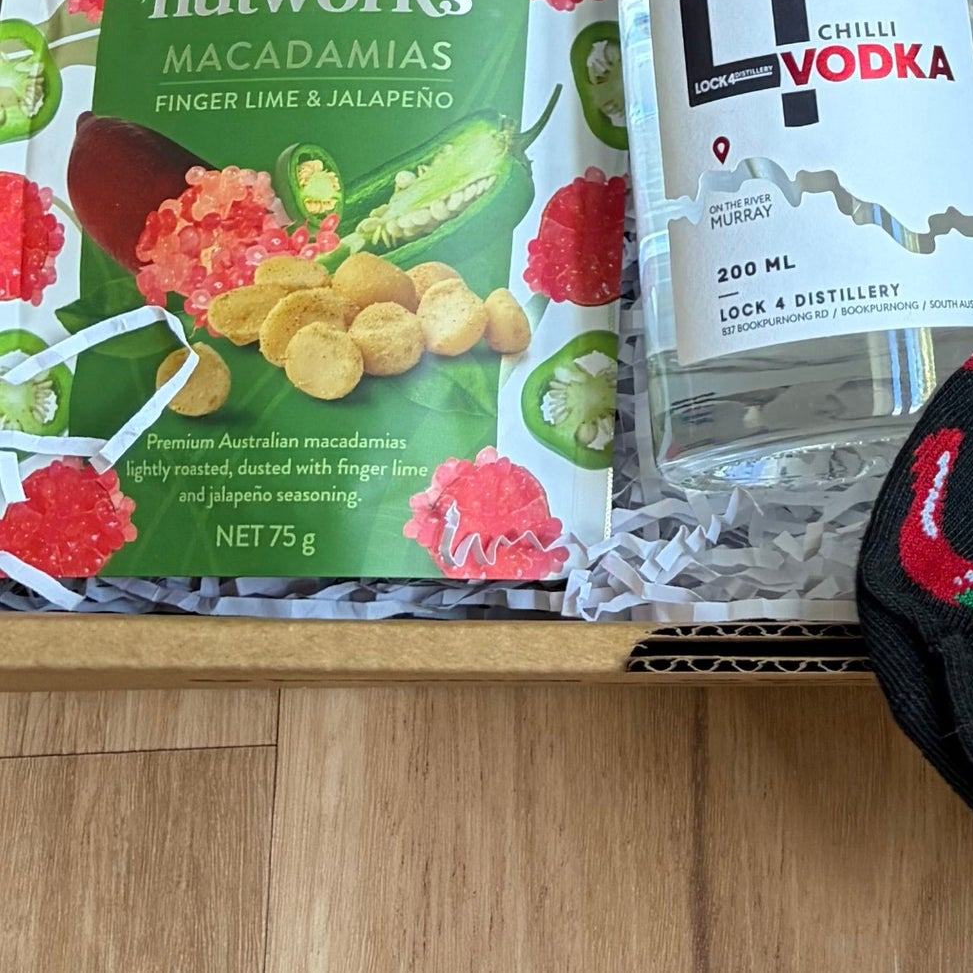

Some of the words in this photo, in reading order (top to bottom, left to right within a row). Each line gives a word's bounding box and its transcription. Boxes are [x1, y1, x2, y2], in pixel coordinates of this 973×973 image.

[818, 21, 896, 41] CHILLI
[162, 39, 452, 74] MACADAMIAS
[780, 43, 955, 87] VODKA
[735, 65, 773, 79] DISTILLERY
[155, 91, 239, 112] FINGER
[245, 90, 300, 109] LIME
[306, 90, 322, 108] &
[326, 86, 454, 109] JALAPEÑO
[709, 205, 723, 215] ON
[724, 199, 742, 210] THE
[744, 193, 771, 206] RIVER
[710, 204, 773, 230] MURRAY
[717, 261, 757, 283] 200
[765, 255, 796, 273] ML
[720, 299, 766, 322] LOCK
[775, 297, 786, 310] 4
[795, 283, 900, 307] DISTILLERY
[722, 325, 736, 336] 837
[737, 312, 813, 333] BOOKPURNONG
[815, 309, 829, 319] RD
[841, 301, 919, 316] BOOKPURNONG
[930, 299, 958, 309] SOUTH
[147, 433, 214, 450] Premium
[218, 432, 299, 449] Australian
[304, 432, 407, 450] macadamias
[126, 460, 171, 482] lightly
[174, 459, 233, 478] roasted,
[238, 458, 291, 476] dusted
[296, 458, 331, 476] with
[337, 459, 388, 481] finger
[391, 459, 428, 477] lime
[178, 486, 205, 502] and
[206, 485, 272, 509] jalapeño
[276, 485, 362, 509] seasoning.
[216, 525, 264, 547] NET
[269, 525, 296, 547] 75
[301, 531, 316, 556] g
